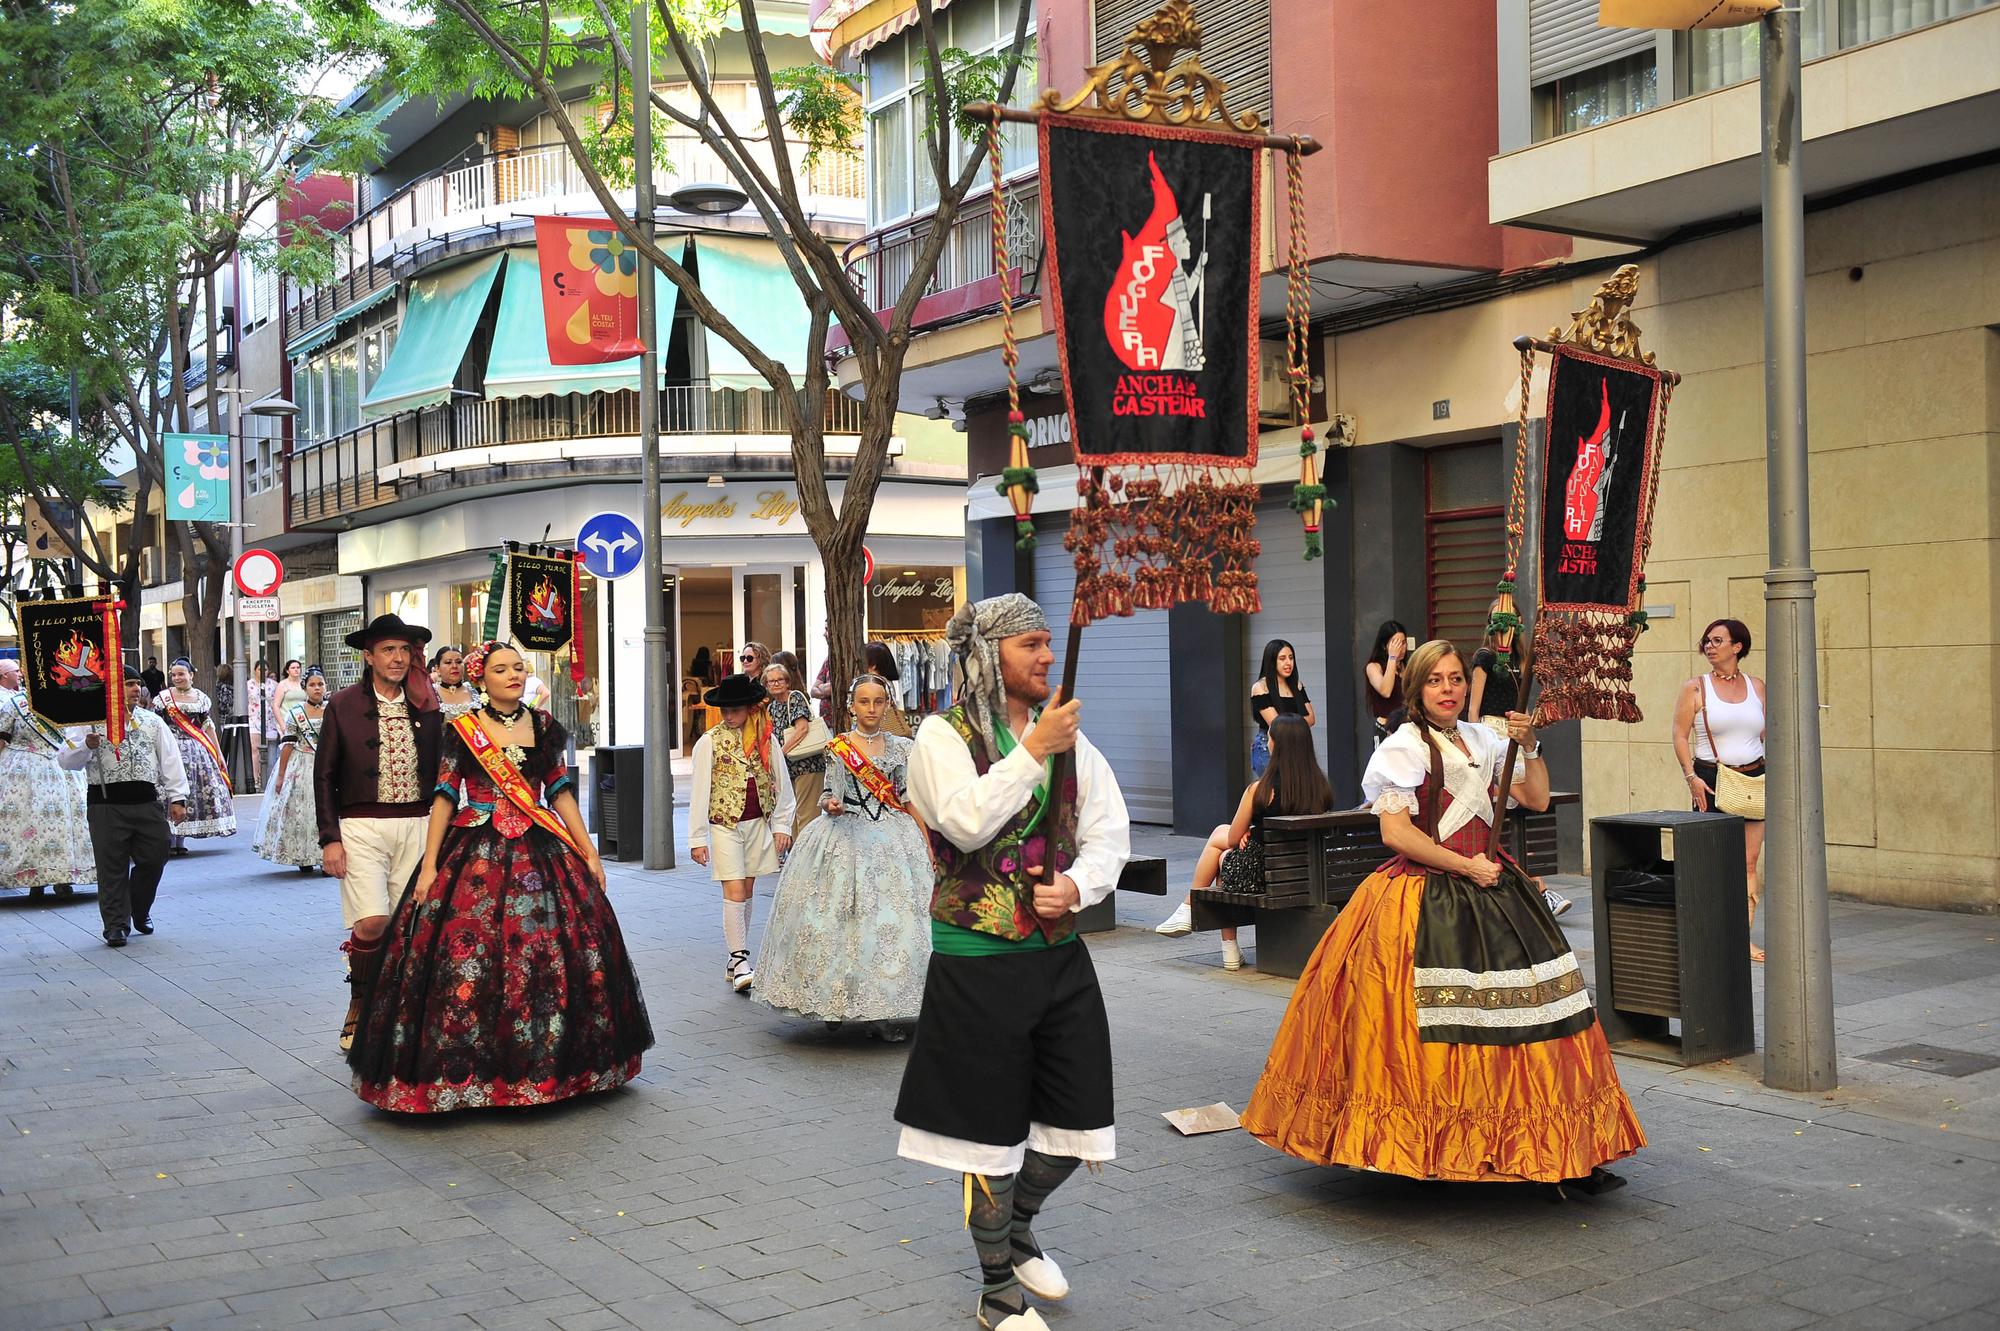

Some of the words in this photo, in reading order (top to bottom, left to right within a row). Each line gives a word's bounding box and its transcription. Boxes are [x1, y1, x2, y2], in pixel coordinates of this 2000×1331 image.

[1119, 245, 1164, 367] FOGUERA
[592, 320, 615, 328] COSTAT
[1566, 443, 1597, 533] FOGUERA
[872, 577, 925, 603] Angeles
[33, 617, 67, 627] LILLO
[72, 614, 104, 625] JUAN
